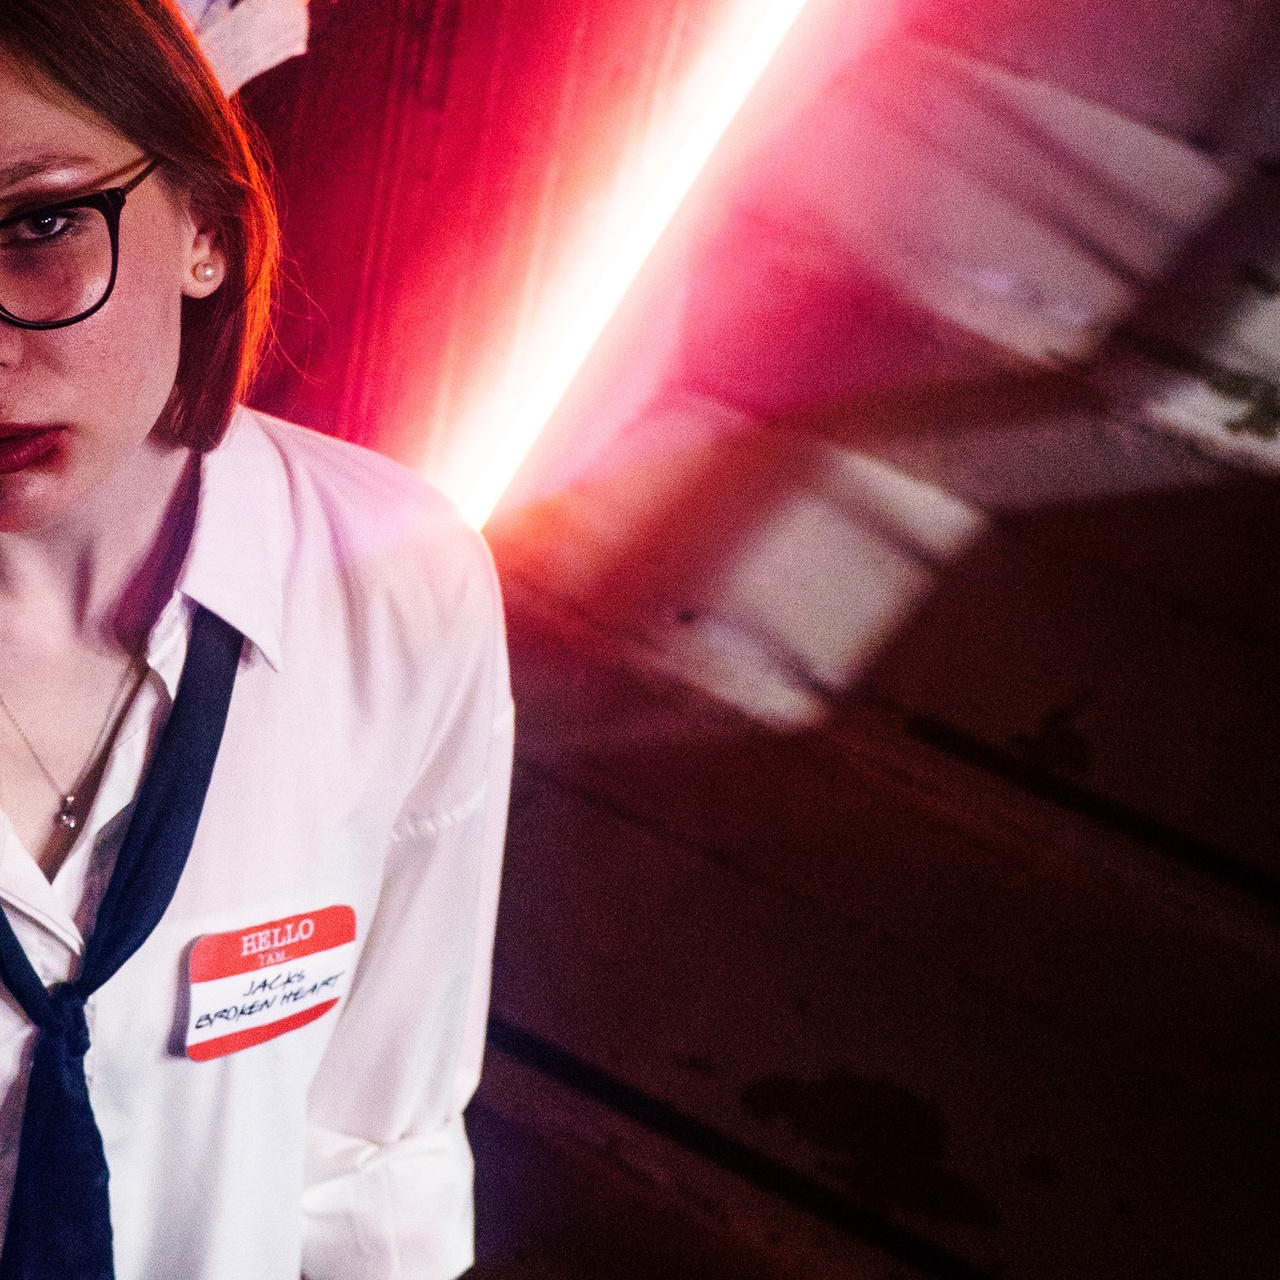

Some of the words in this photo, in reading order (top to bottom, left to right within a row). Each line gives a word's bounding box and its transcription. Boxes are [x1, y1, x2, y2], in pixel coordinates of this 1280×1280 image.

[241, 919, 314, 956] HELLO
[195, 995, 275, 1029] BROKEN
[280, 971, 345, 1006] HEART
